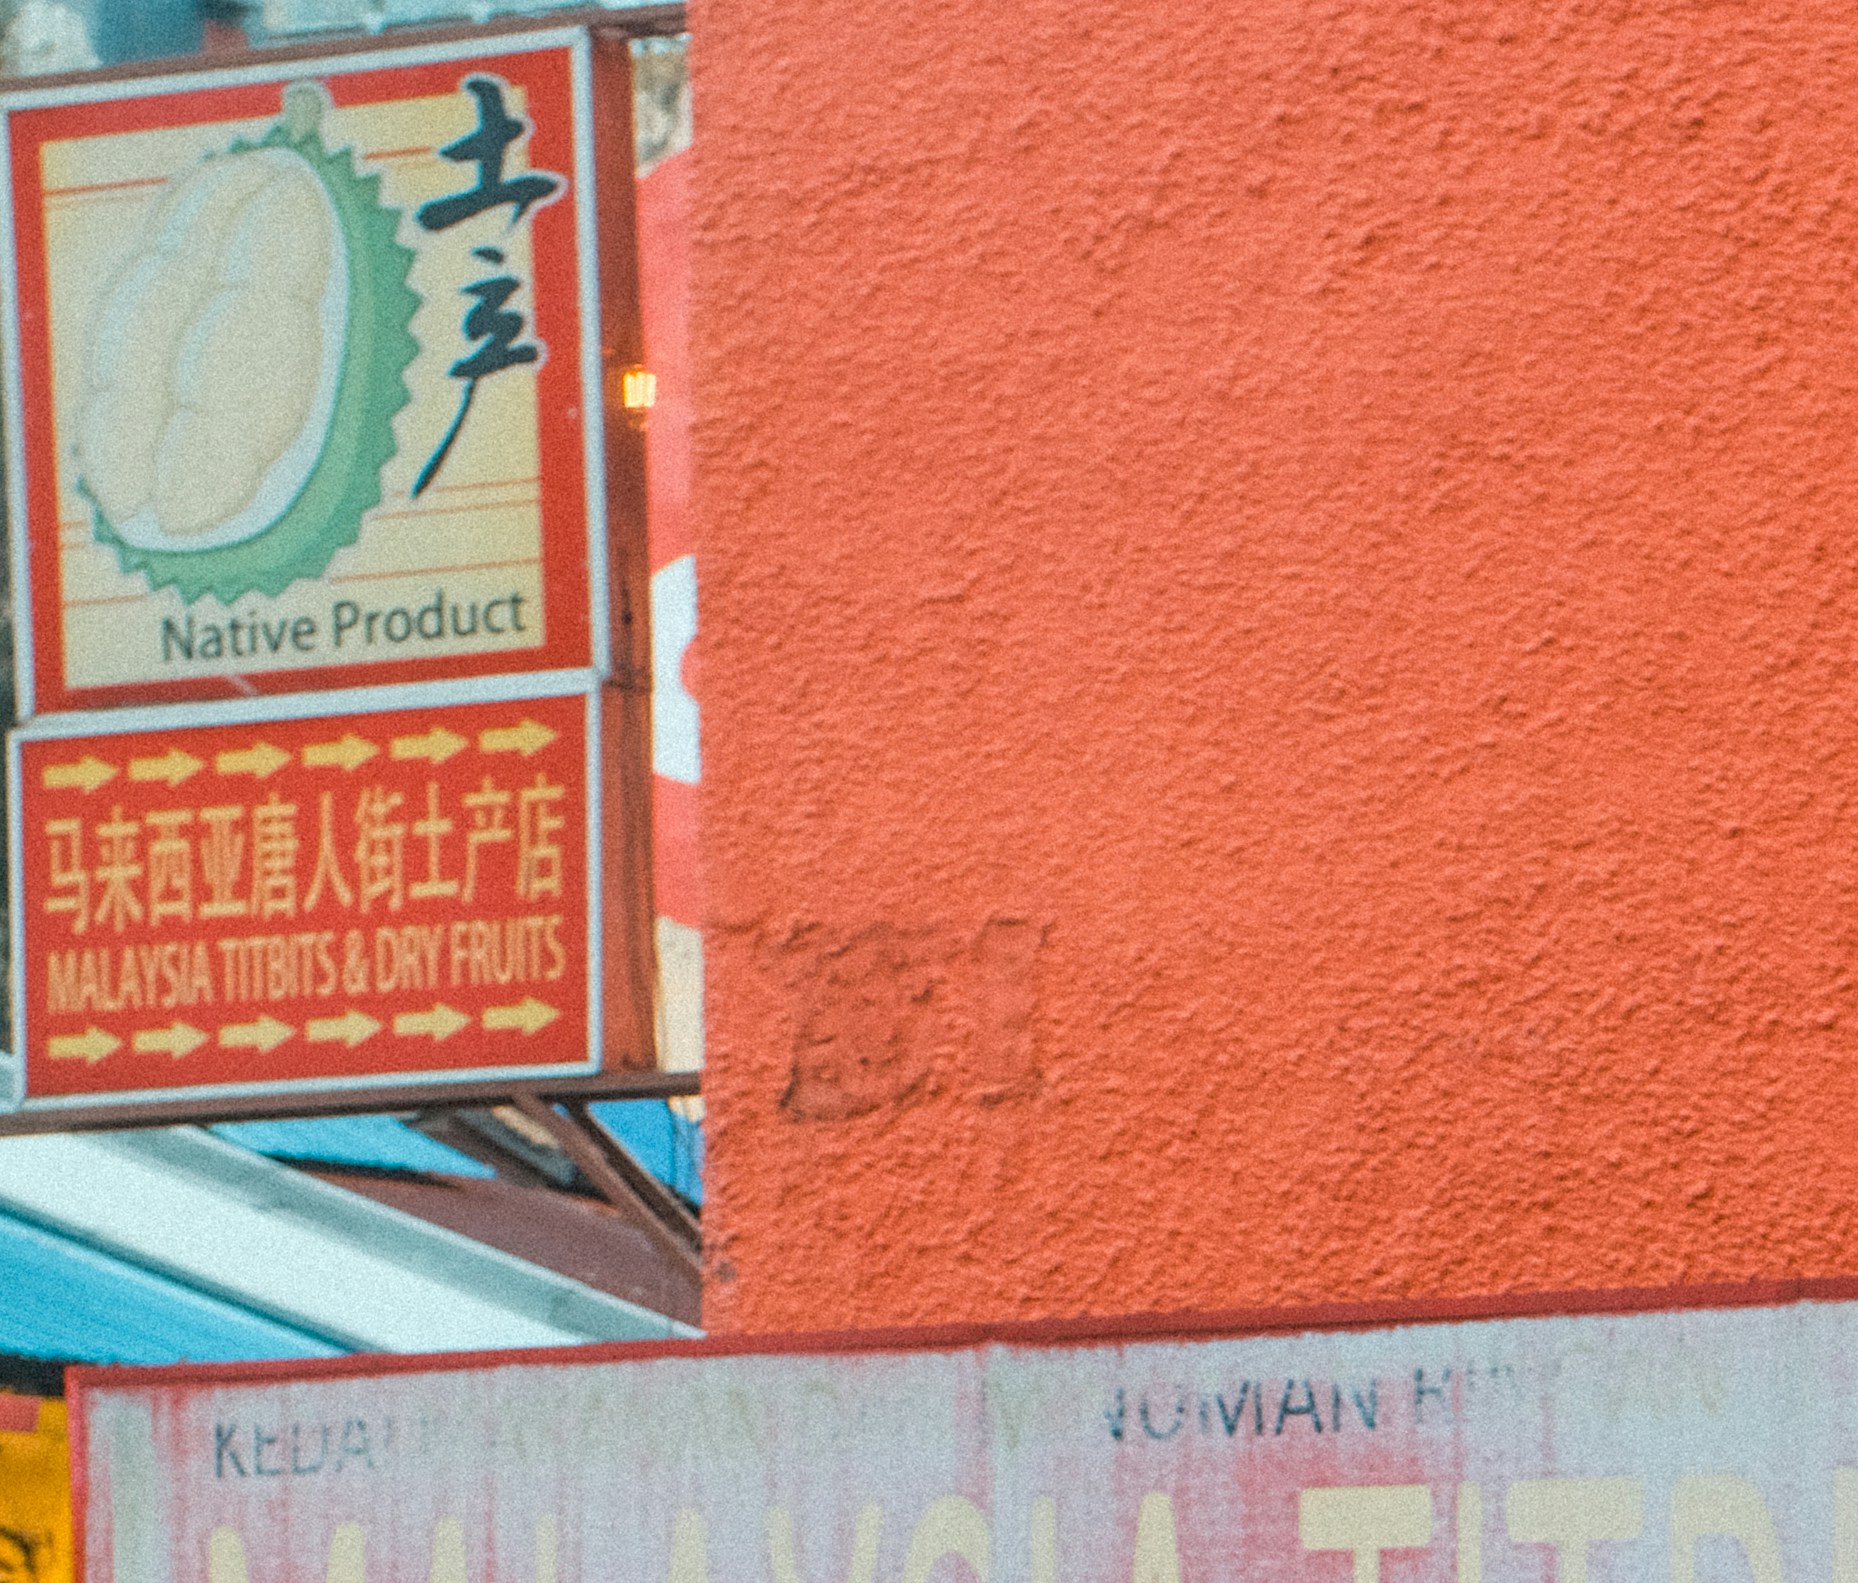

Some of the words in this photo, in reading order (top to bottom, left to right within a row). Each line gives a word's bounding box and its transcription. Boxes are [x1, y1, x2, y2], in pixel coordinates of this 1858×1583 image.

[161, 612, 316, 662] Native
[332, 590, 528, 648] Product
[43, 773, 566, 935] 马来西亚唐人街土产店
[46, 939, 214, 1013] MALAYSIA
[216, 928, 336, 1003] TITBITS
[341, 929, 369, 996] &
[375, 921, 441, 994] DRY
[449, 914, 567, 990] FRUITS
